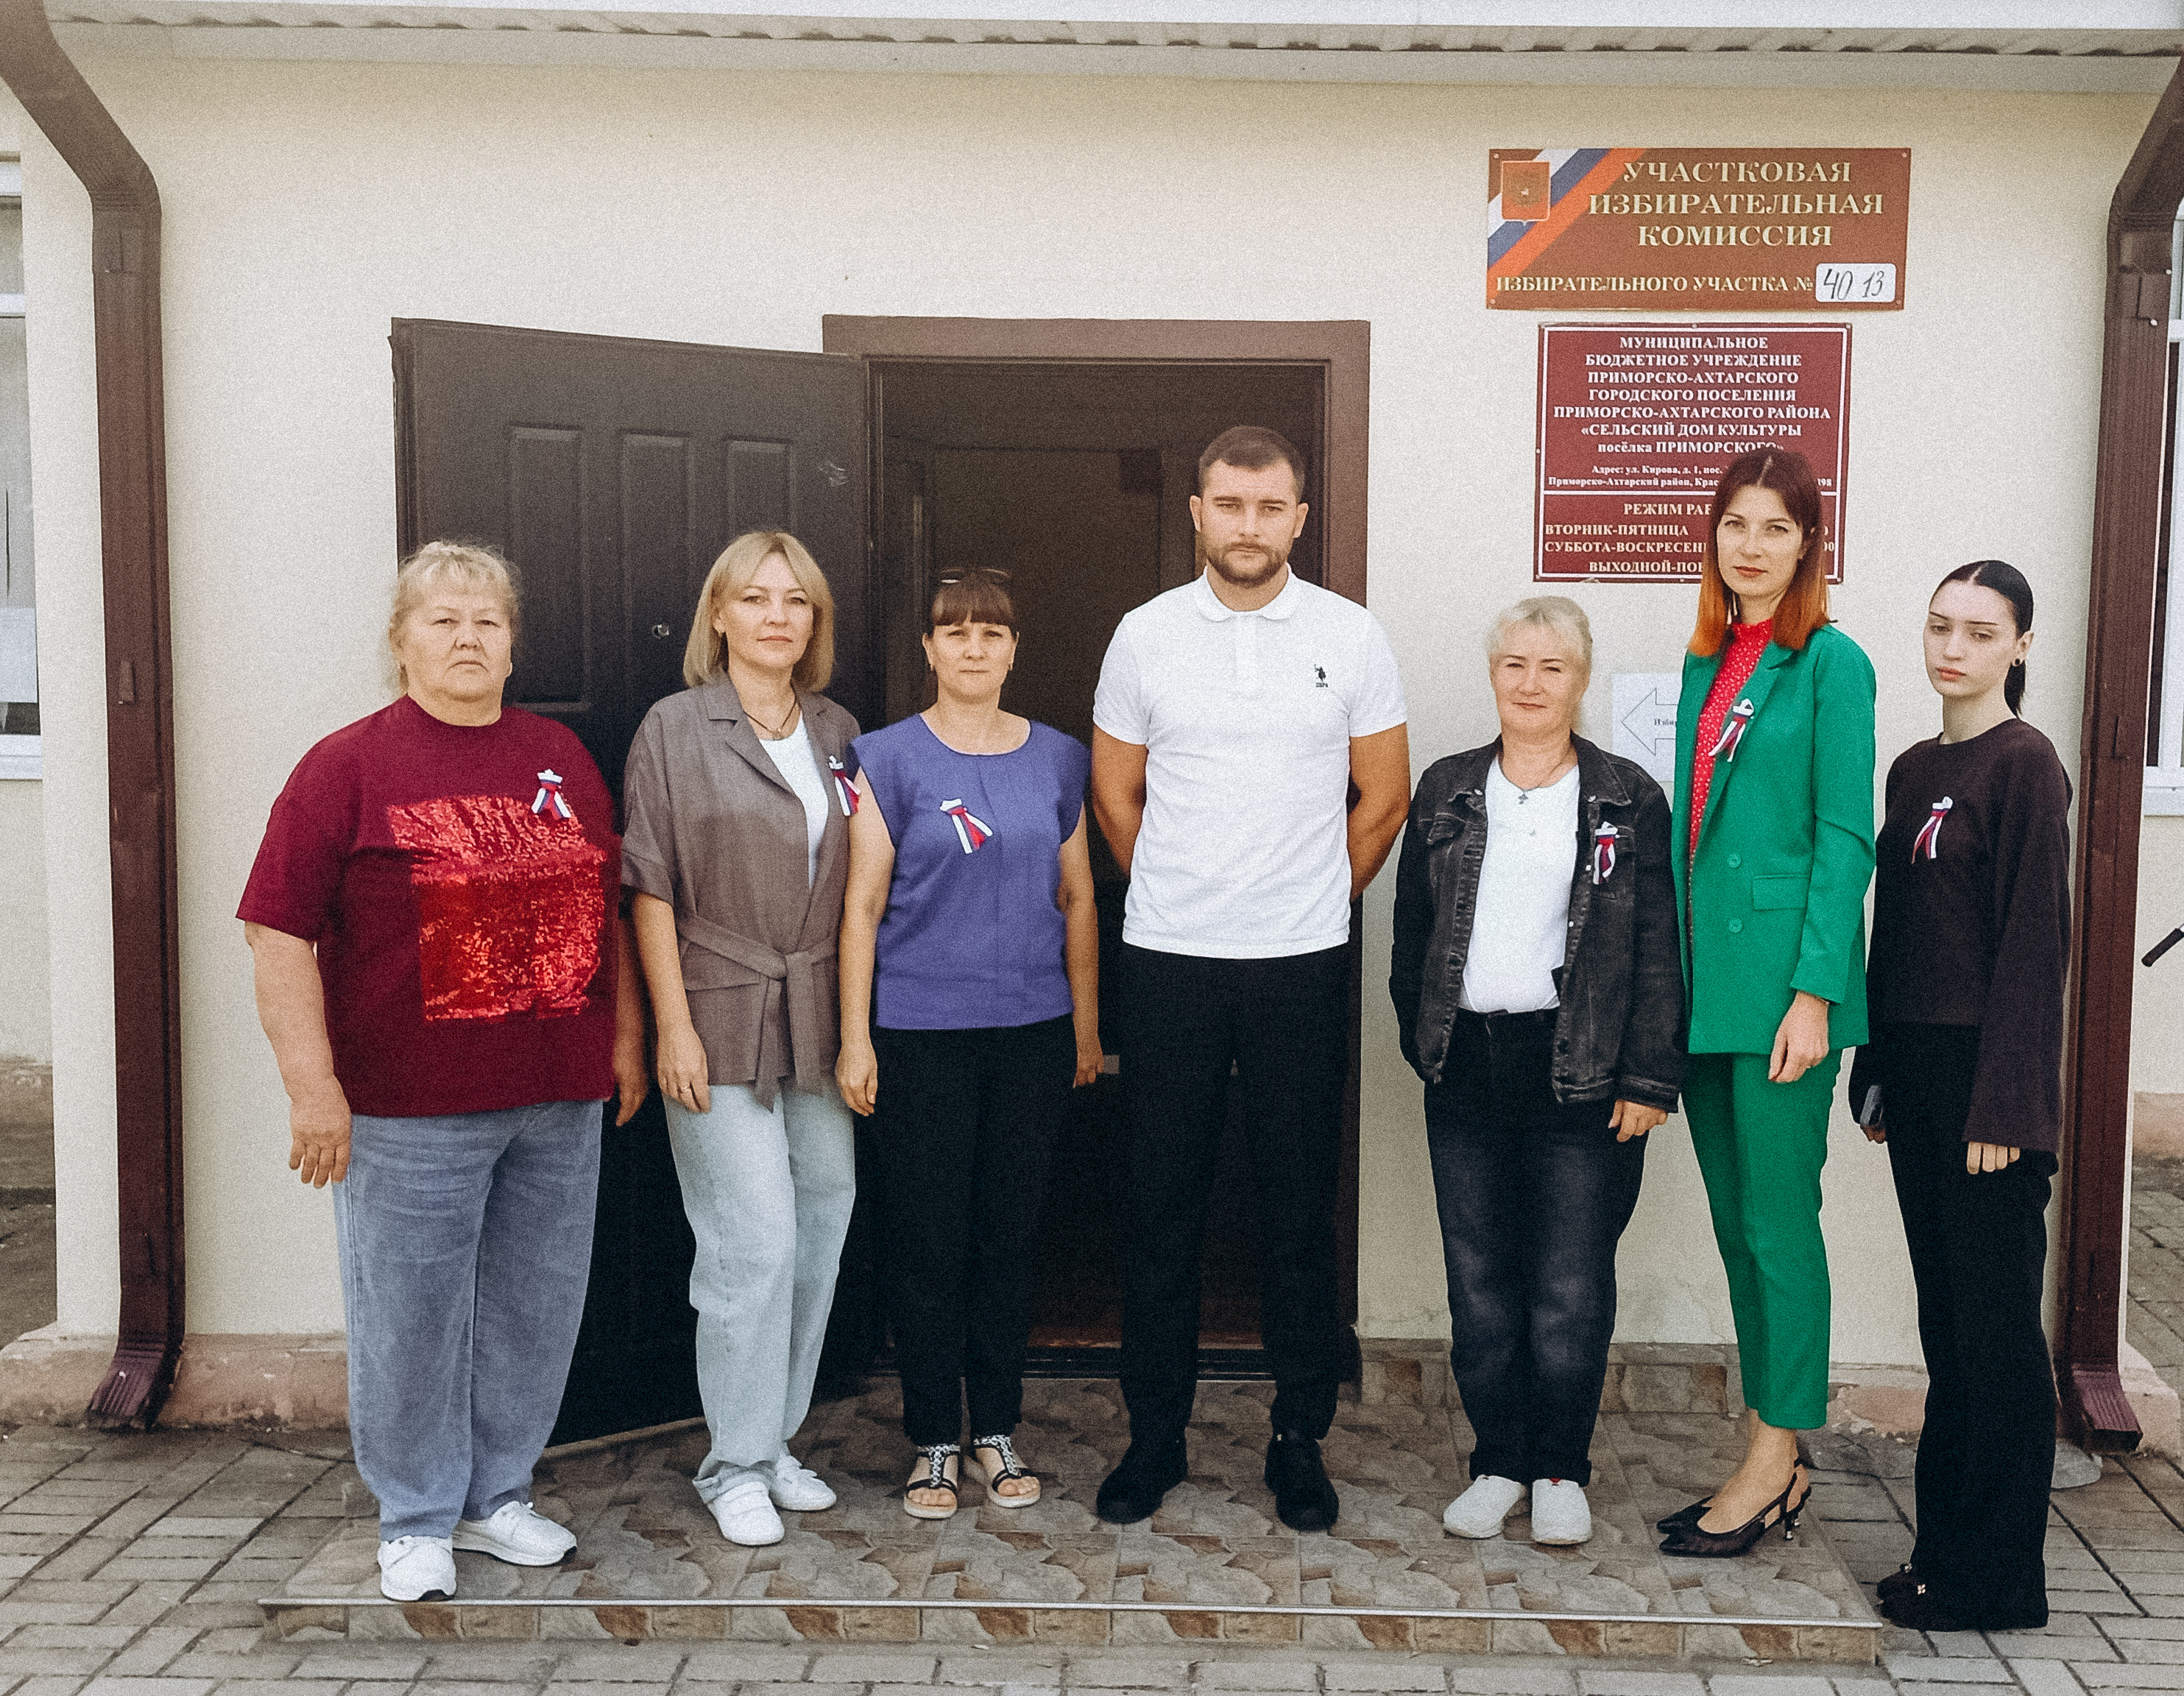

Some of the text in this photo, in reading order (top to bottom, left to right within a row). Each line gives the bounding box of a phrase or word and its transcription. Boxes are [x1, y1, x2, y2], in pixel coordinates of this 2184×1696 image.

[1623, 161, 1851, 183] УЧАСТКОВАЯ
[1588, 193, 1884, 215] ИЗБИРАТЕЛЬНАЯ
[1638, 225, 1832, 247] КОМИССИЯ
[1496, 276, 1689, 292] ИЗБИРАТЕЛЬНОГО
[1692, 275, 1789, 292] УЧАСТКА
[1792, 276, 1814, 292] №
[1619, 337, 1768, 350] МУНИЦИПАЛЬНОЕ
[1585, 353, 1802, 367] БЮДЖЕТНОЕ УЧРЕЖДЕНИЕ
[1588, 371, 1799, 384] ПРИМОРСКО-АХТАРСКОГО
[1588, 389, 1796, 403] ГОРОДСКОГО ПОСЕЛЕНИЯ
[1554, 404, 1831, 420] ПРИМОРСКО-АХТАРСКОГО РАЙОНА
[1580, 422, 1802, 437] «СЕЛЬСКИЙ ДОМ КУЛЬТУРЫ
[1597, 441, 1653, 454] посёлка
[1591, 465, 1624, 476] Адрес:
[1625, 467, 1640, 476] ул.
[1641, 465, 1681, 476] Кирова,
[1703, 467, 1723, 475] пос.
[1548, 476, 1658, 488] Приморско-Ахтарский
[1623, 504, 1683, 515] РЕЖИМ
[1545, 524, 1689, 537] ВТОРНИК-ПЯТНИЦА
